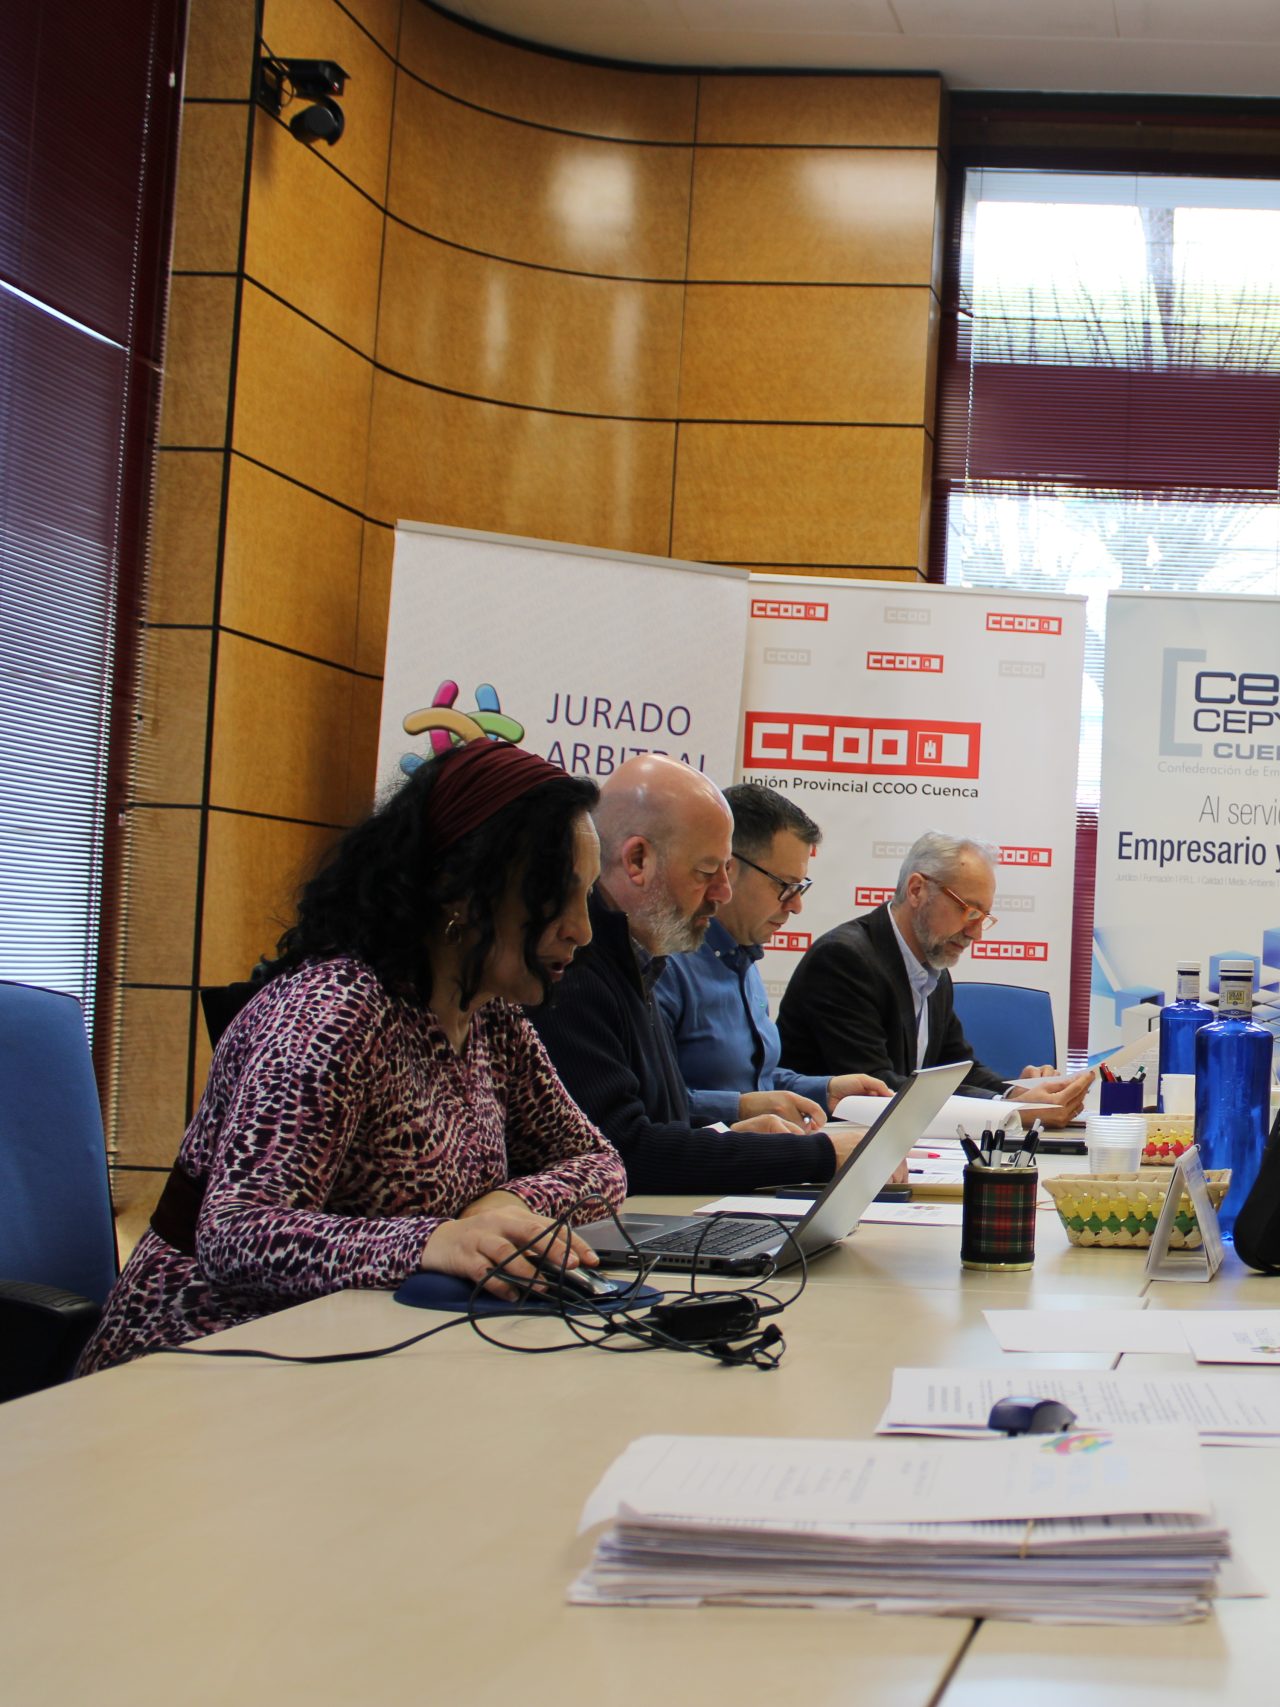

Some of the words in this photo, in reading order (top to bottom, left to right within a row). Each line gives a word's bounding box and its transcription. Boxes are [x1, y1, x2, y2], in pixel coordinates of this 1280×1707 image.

[546, 692, 691, 736] JURADO
[751, 722, 908, 765] CCOO
[1157, 761, 1241, 776] Confederación
[1245, 766, 1259, 777] de
[793, 777, 868, 794] Provincial
[872, 781, 918, 795] CCOO
[921, 784, 979, 798] Cuenca
[1199, 795, 1219, 824] Al
[1118, 831, 1267, 868] Empresario
